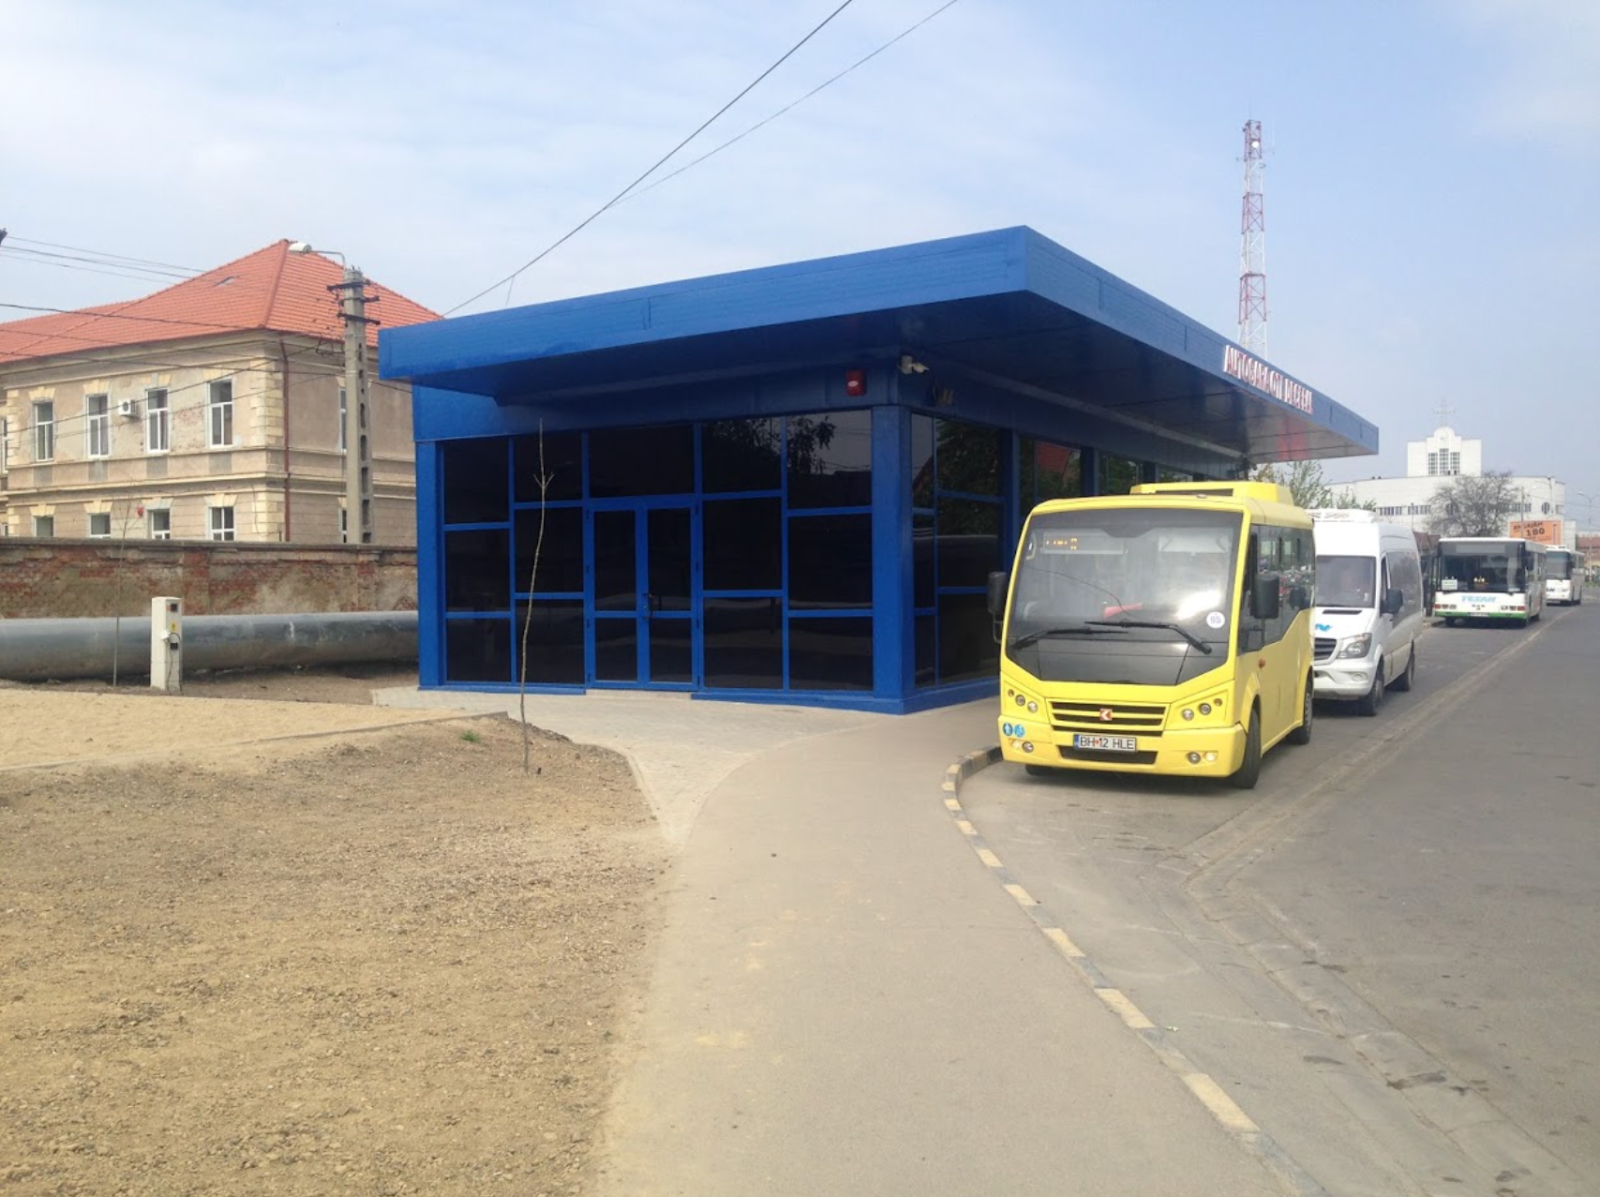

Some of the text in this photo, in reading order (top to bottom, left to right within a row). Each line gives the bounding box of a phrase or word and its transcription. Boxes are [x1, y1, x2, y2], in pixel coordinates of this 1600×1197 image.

[1526, 527, 1546, 537] 180
[1080, 736, 1135, 750] BH 12 HLE
